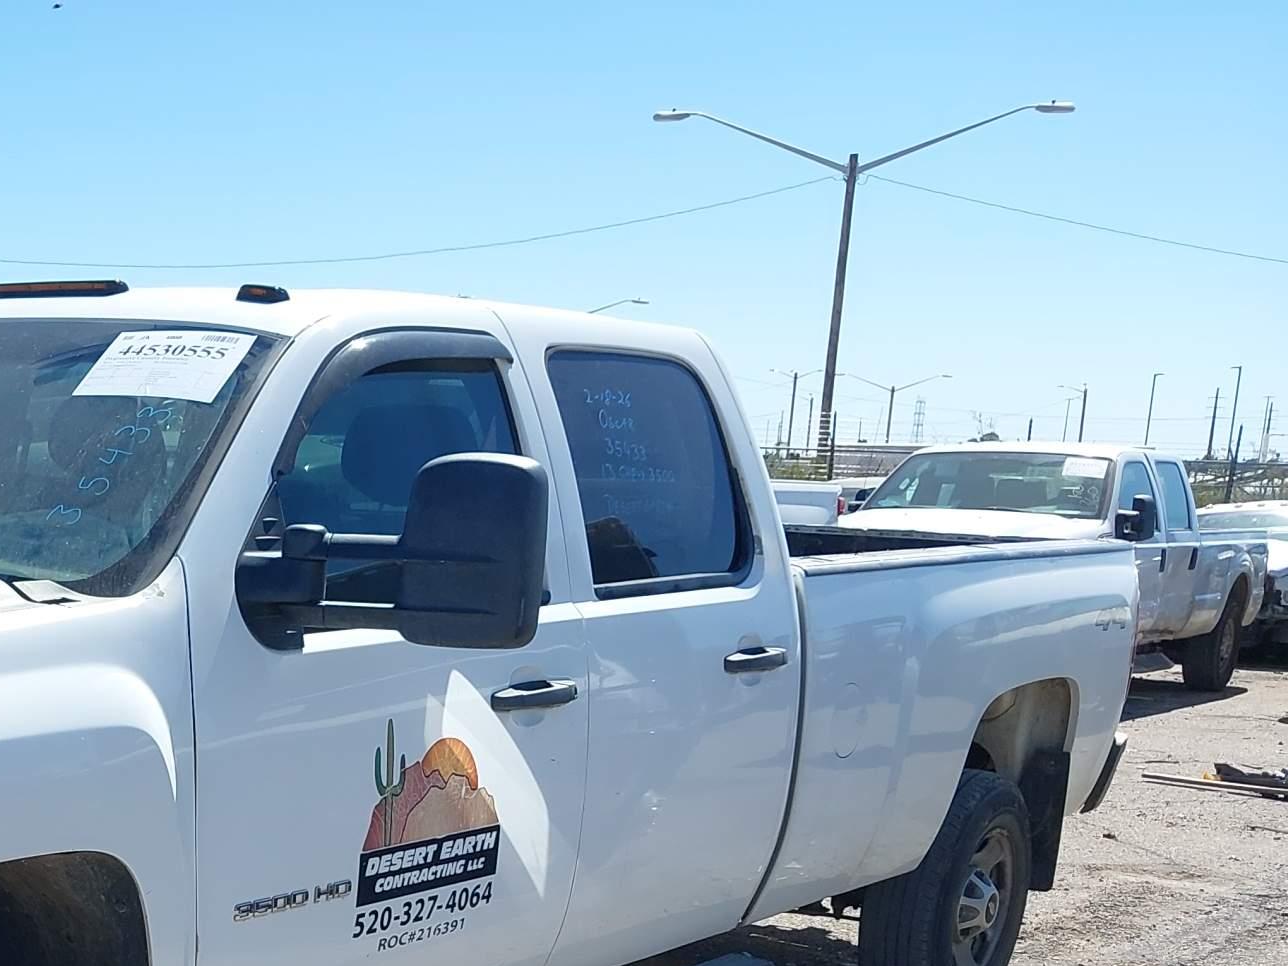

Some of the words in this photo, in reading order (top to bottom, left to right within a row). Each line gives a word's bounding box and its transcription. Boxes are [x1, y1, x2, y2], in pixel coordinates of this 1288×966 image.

[118, 344, 230, 360] 44530555
[365, 843, 438, 877] DESERT
[439, 830, 498, 860] EARTH
[314, 879, 352, 904] HD
[374, 859, 465, 893] CONTRACTING
[466, 857, 486, 872] LLC
[351, 880, 493, 939] 520-327-4064
[377, 917, 465, 952] ROC#216391
